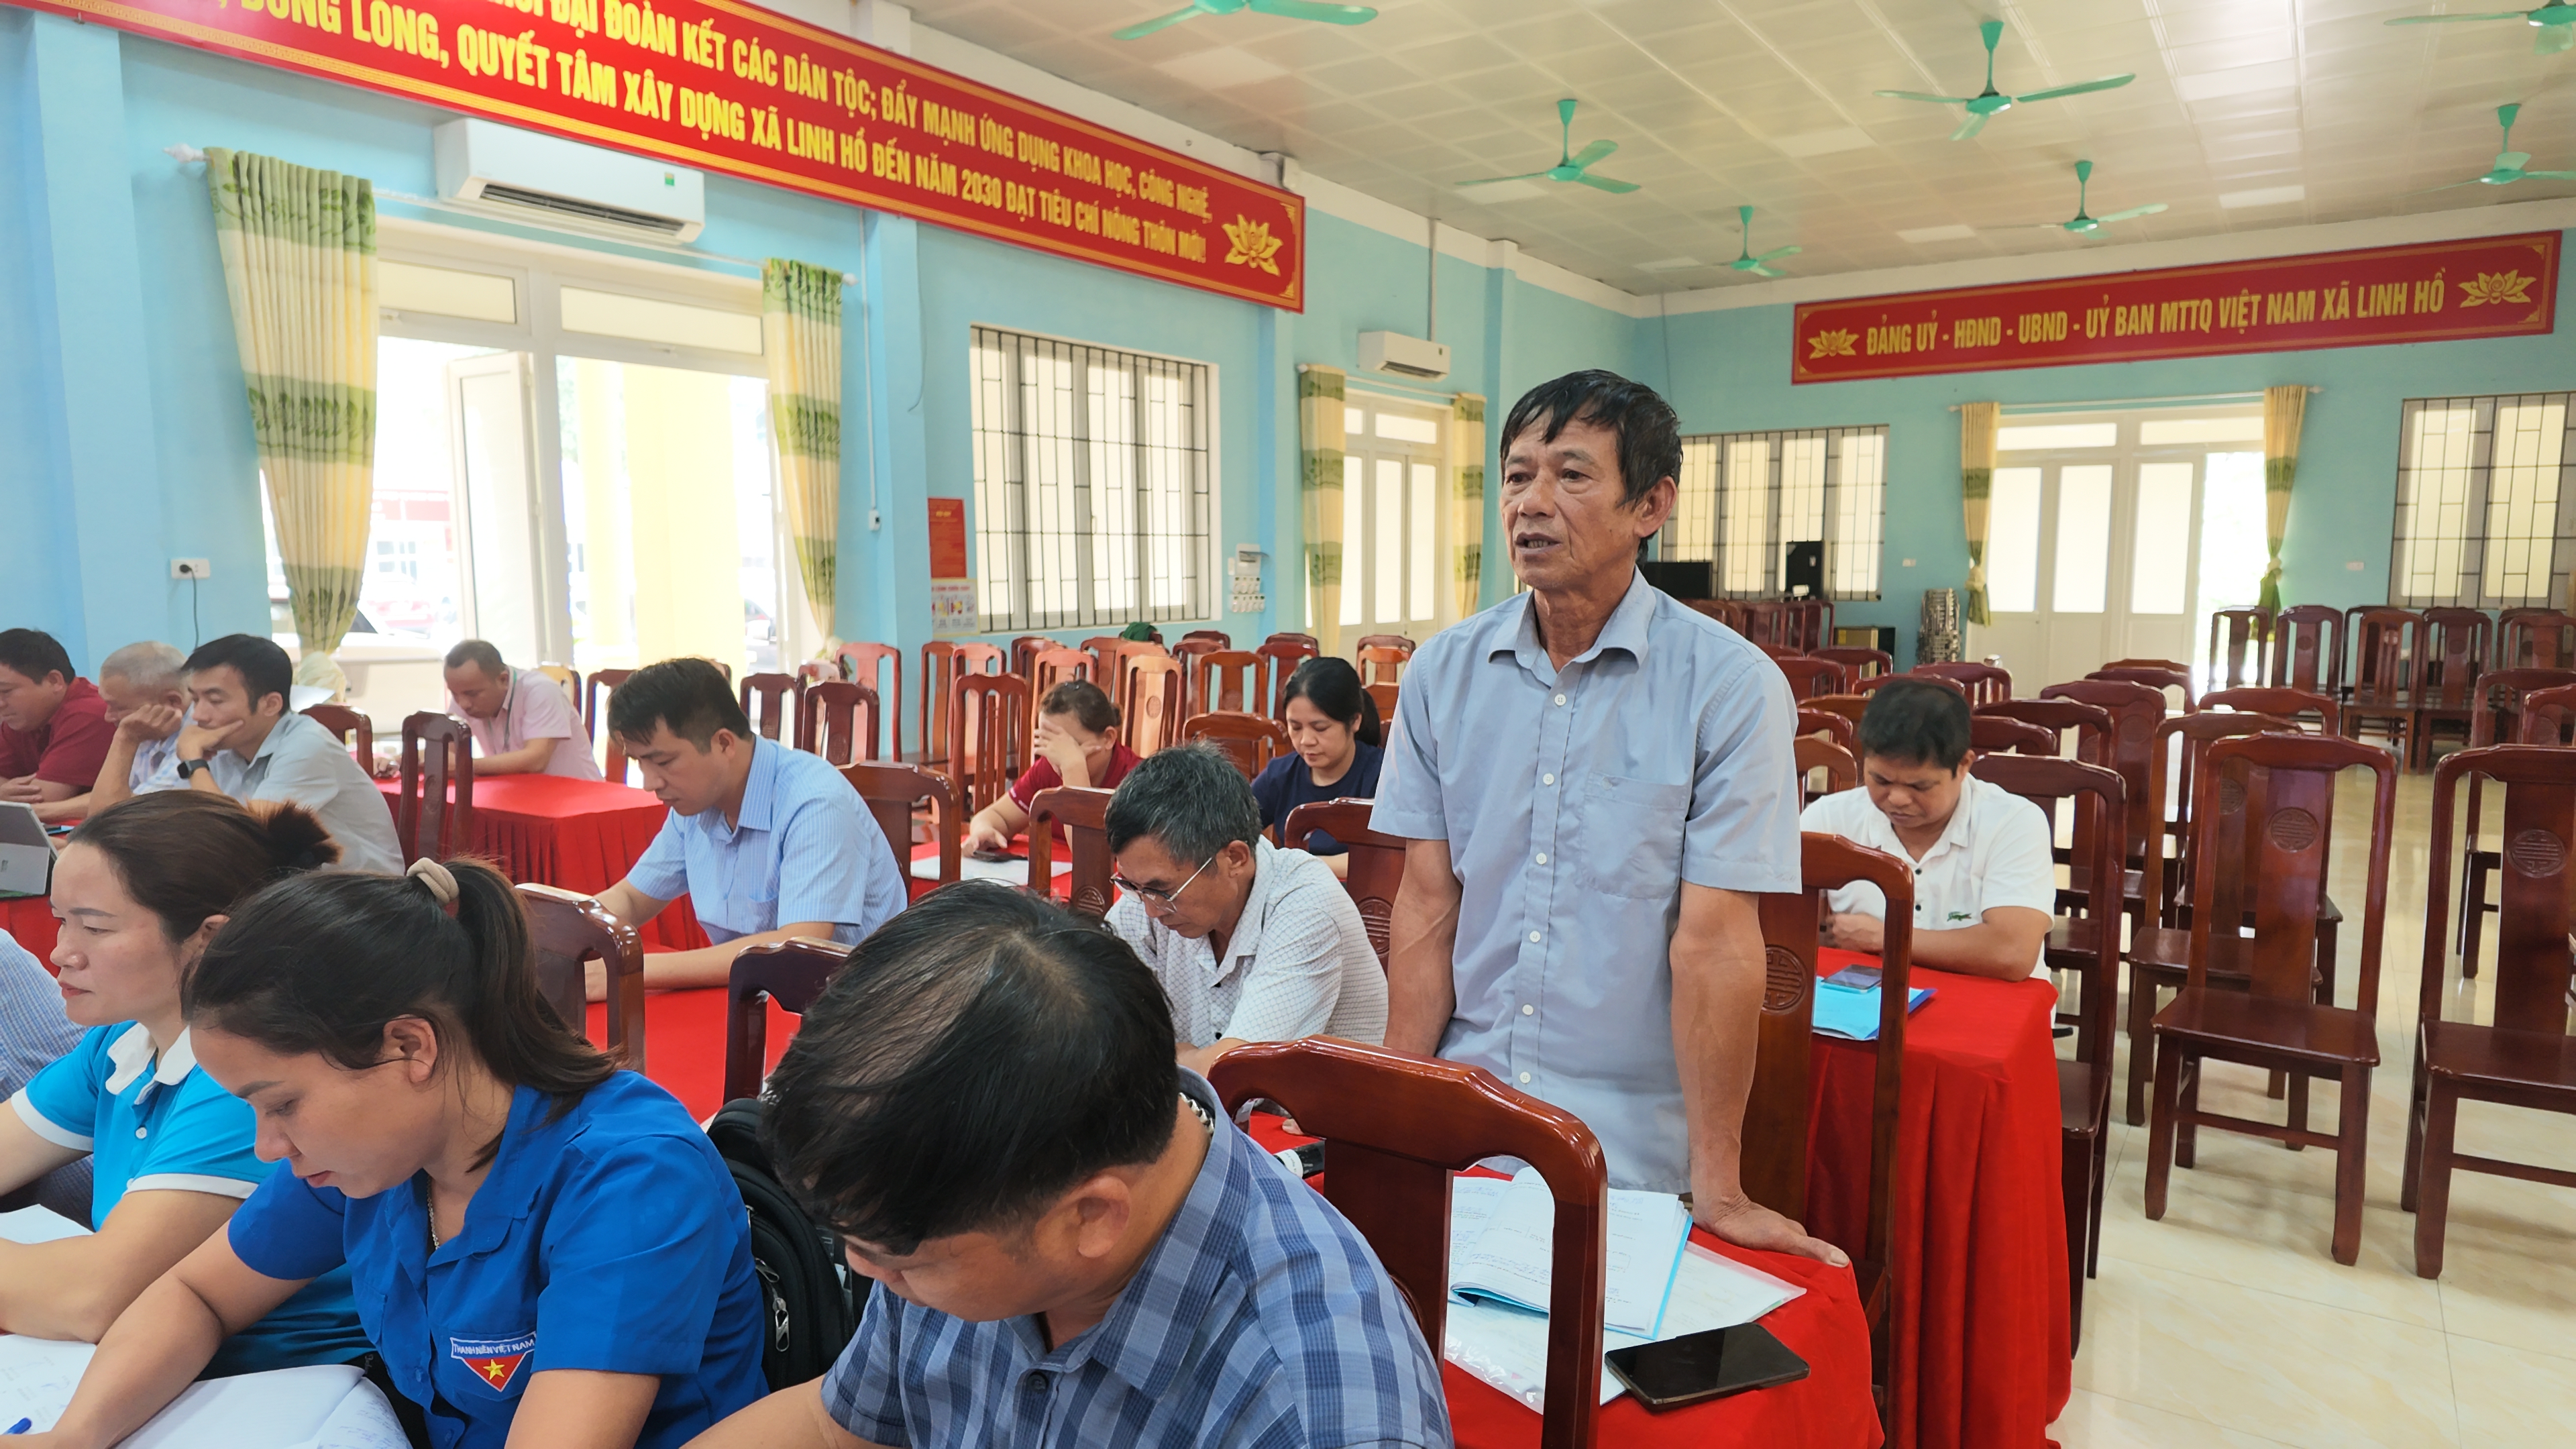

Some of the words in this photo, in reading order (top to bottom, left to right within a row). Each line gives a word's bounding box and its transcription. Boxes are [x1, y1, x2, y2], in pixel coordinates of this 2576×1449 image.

[457, 23, 550, 90] QUYẾT
[556, 48, 616, 108] TÂM
[623, 68, 674, 121] XÂY
[680, 87, 745, 141] DỰNG
[751, 105, 782, 151] XÃ
[787, 117, 835, 164] LINH
[871, 137, 911, 185] ĐẾN
[915, 152, 957, 197] NĂM
[961, 168, 1002, 209] 2030
[1006, 180, 1035, 222] ĐẠT
[1039, 189, 1072, 227] TIÊU
[1075, 200, 1099, 235] CHÍ
[1102, 206, 1140, 246] NÔNG
[1142, 219, 1176, 256] THÔN
[604, 0, 676, 57] ĐOÀN
[682, 17, 727, 72] KẾT
[732, 37, 778, 87] CÁC
[784, 53, 828, 103] DÂN
[833, 68, 877, 121] TỘC;
[881, 78, 918, 129] ĐẨY
[922, 99, 976, 147] MẠNH
[979, 113, 1014, 159] ỨNG
[1017, 130, 1061, 173] DỤNG
[1063, 146, 1102, 186] KHOA
[1104, 159, 1137, 200] HỌC,
[1138, 168, 1175, 208] CÔNG
[1867, 314, 1911, 356] ĐẢNG
[1954, 317, 2001, 349] HĐND
[2019, 311, 2068, 344] UBND
[2114, 305, 2155, 337] BAN
[2159, 298, 2213, 333] MTTQ
[2218, 288, 2261, 334] VIỆT
[2266, 290, 2315, 325] NAM
[2322, 280, 2350, 321] XÃ
[2357, 282, 2408, 319] LINH
[2414, 266, 2446, 314] HỒ
[512, 1339, 535, 1350] NAM
